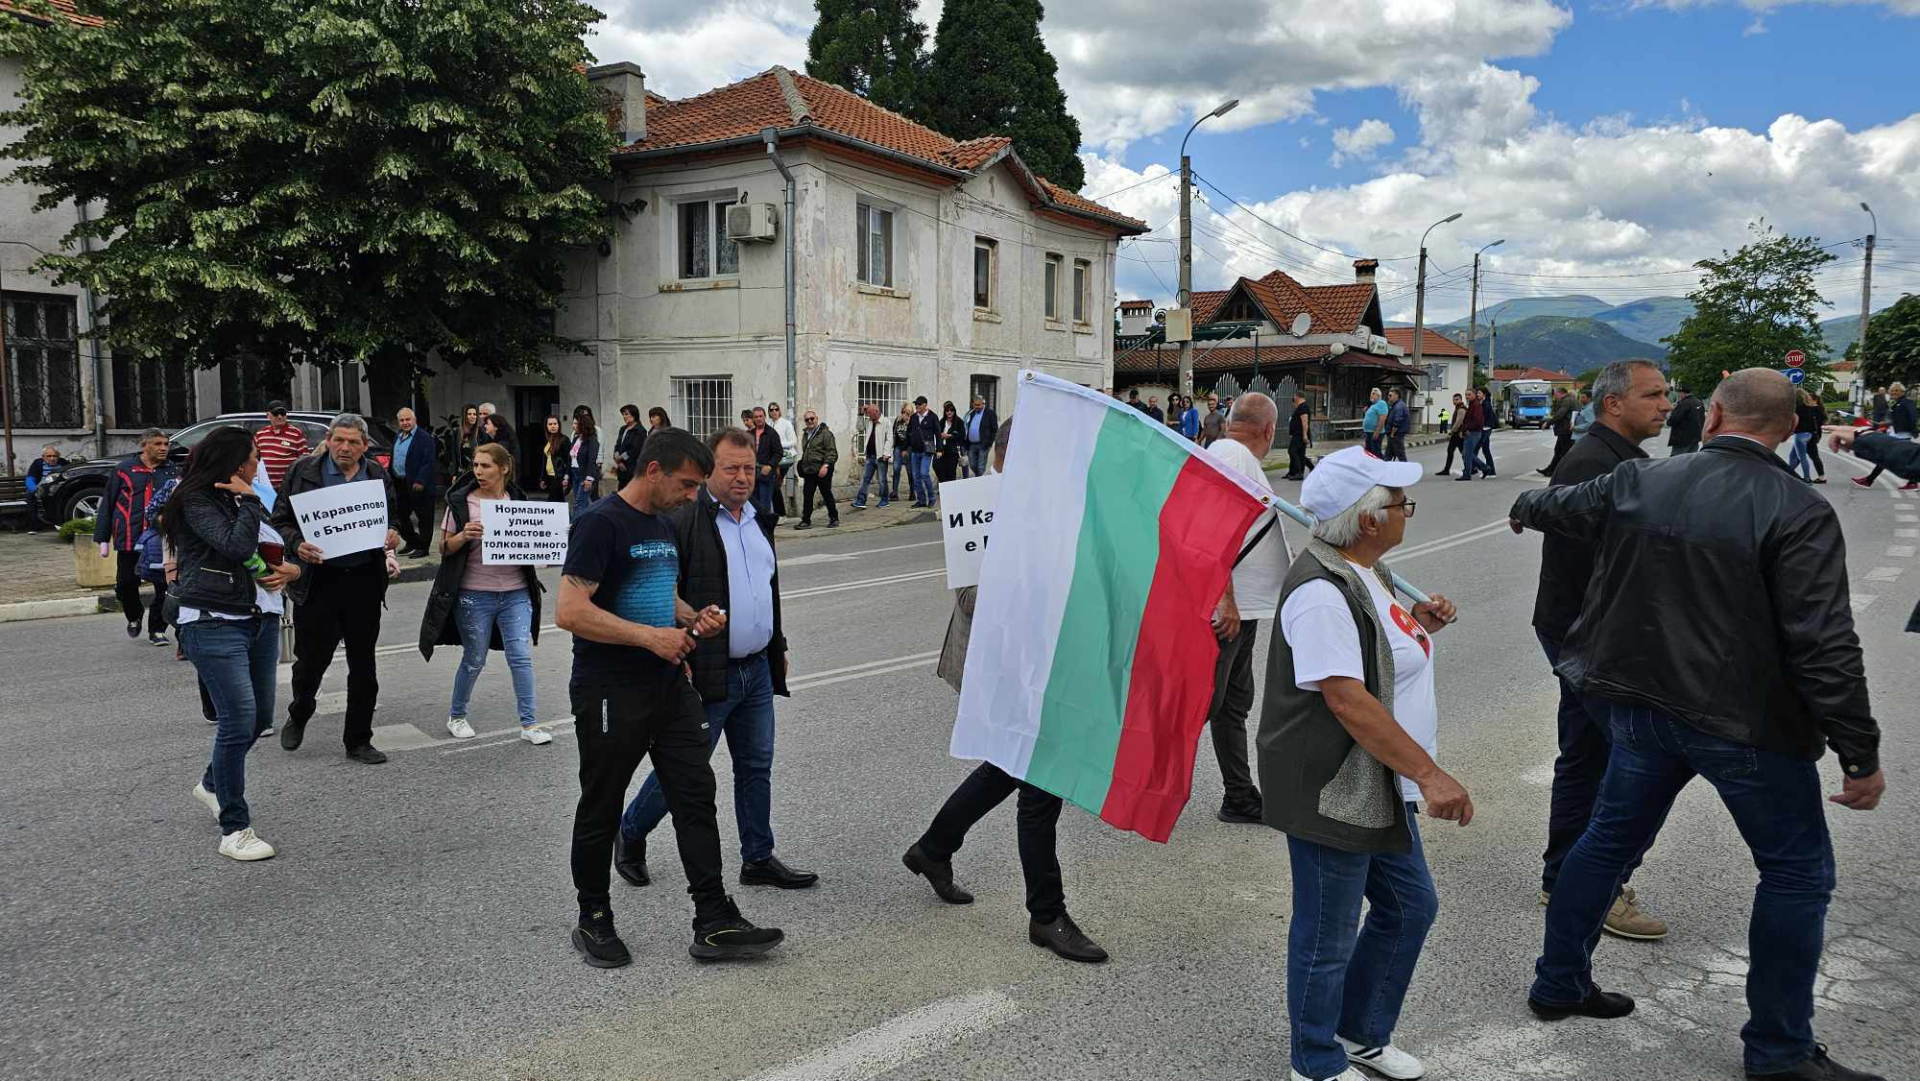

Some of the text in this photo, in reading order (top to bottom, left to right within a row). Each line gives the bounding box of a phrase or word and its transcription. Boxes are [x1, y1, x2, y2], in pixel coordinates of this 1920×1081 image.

[1786, 355, 1804, 363] STOP
[301, 500, 385, 524] И Каравелово
[495, 504, 555, 515] Нормални
[508, 518, 544, 527] улици
[949, 512, 964, 529] И
[313, 515, 386, 538] е България!
[493, 529, 501, 537] и
[504, 530, 552, 538] мостове
[484, 541, 567, 549] толкова много
[964, 540, 977, 552] е
[490, 551, 561, 561] ли искаме?!
